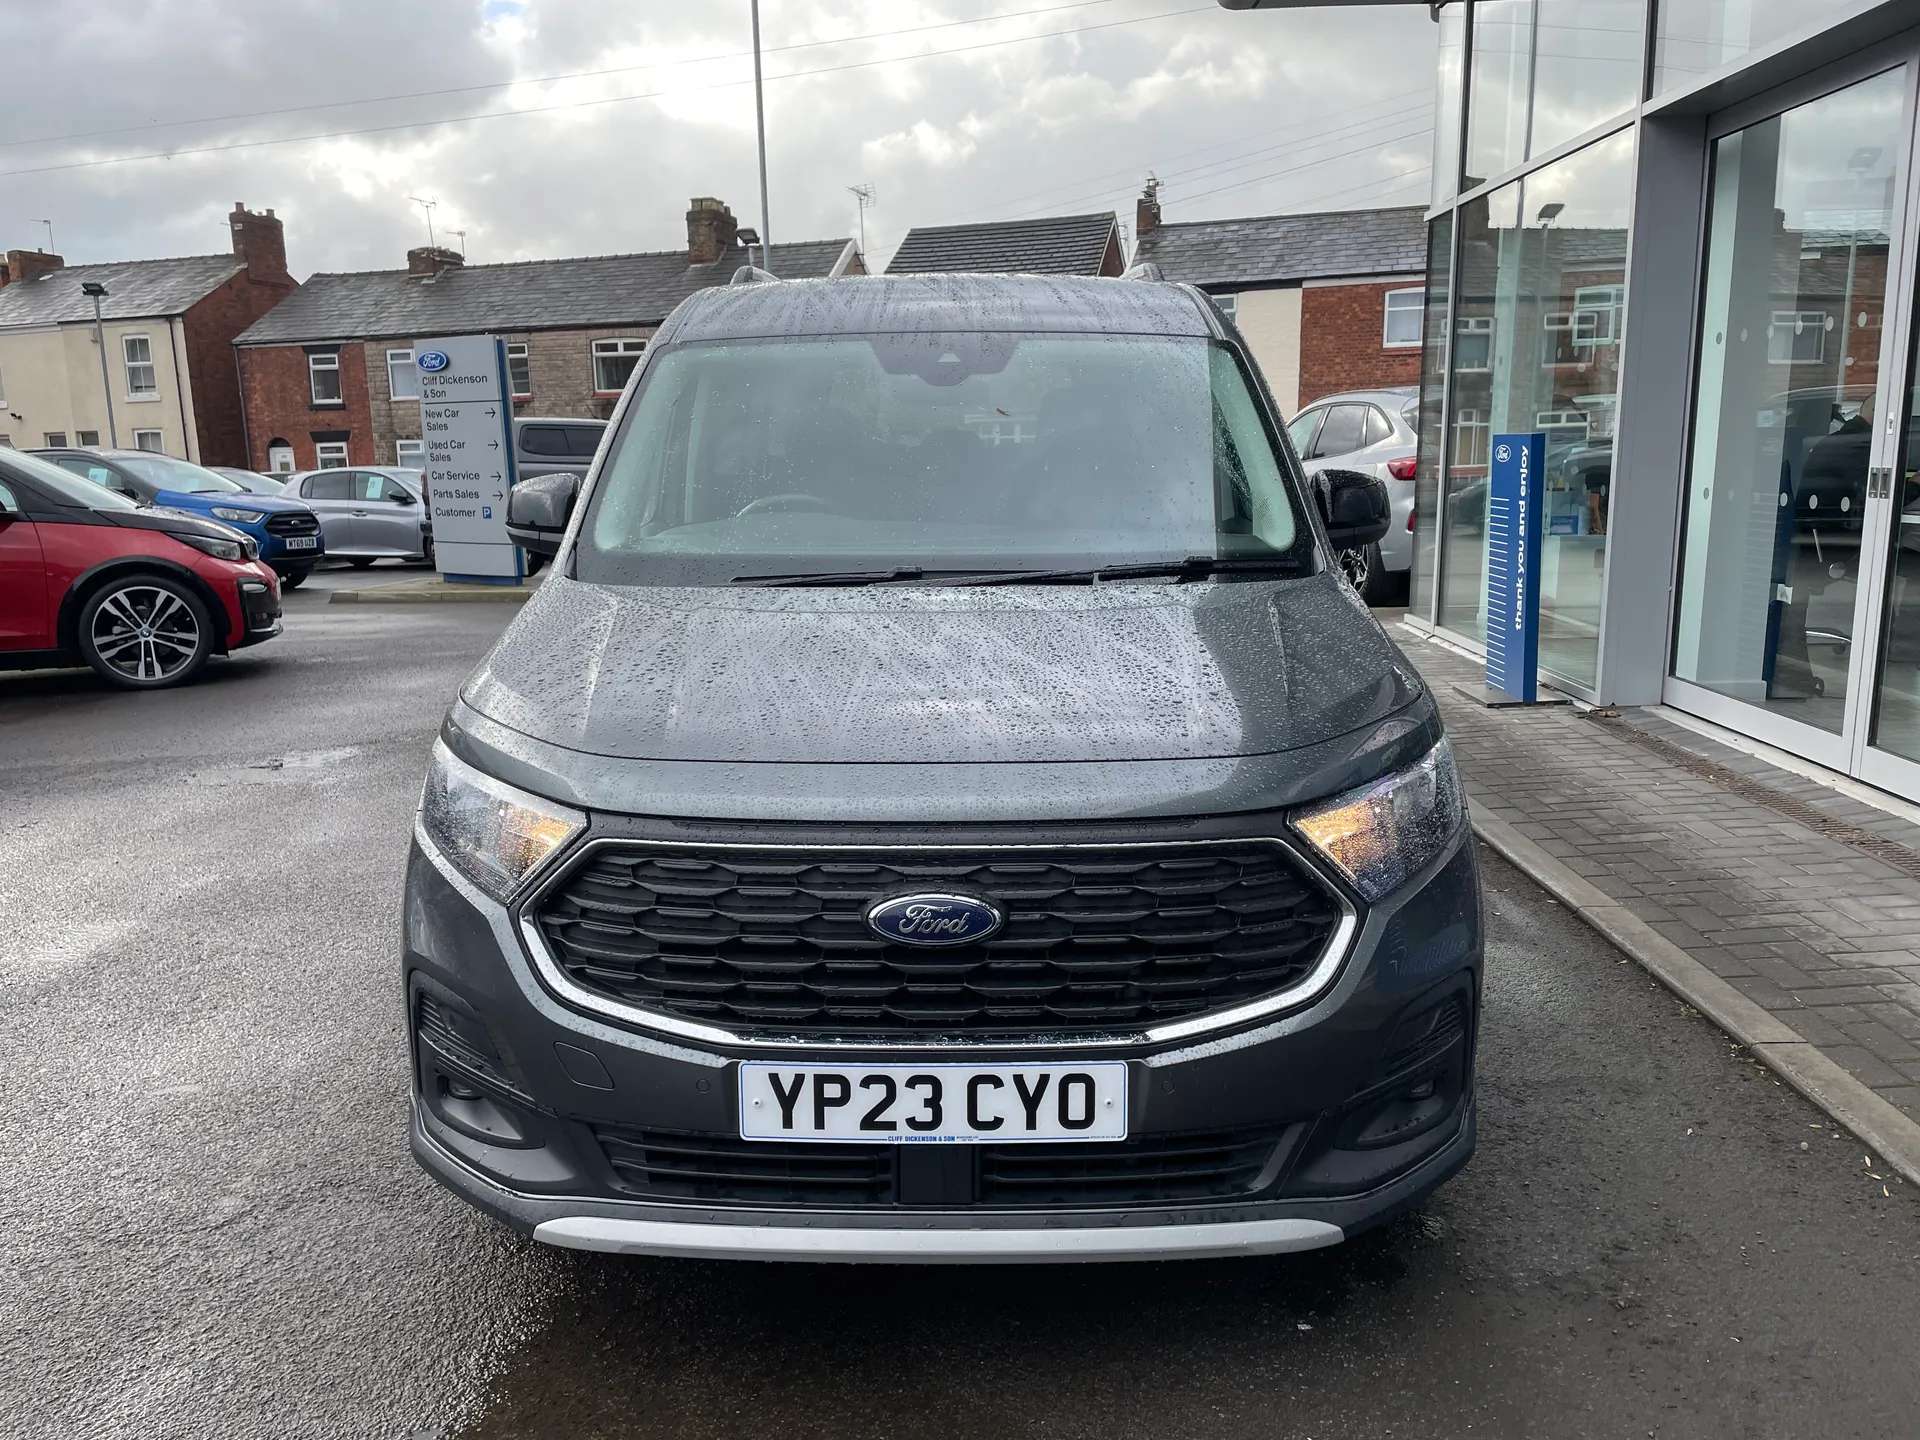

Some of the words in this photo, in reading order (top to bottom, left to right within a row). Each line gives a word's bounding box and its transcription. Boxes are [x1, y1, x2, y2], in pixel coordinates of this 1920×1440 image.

[423, 354, 440, 367] Ford
[422, 376, 438, 386] Cliff
[439, 375, 488, 385] Dickenson
[423, 389, 429, 399] &
[430, 389, 447, 398] Son
[425, 409, 443, 418] New
[444, 408, 459, 418] Car
[426, 422, 449, 431] Sales
[428, 440, 448, 450] Used
[449, 439, 466, 449] Car
[429, 453, 452, 462] Sales
[431, 470, 445, 480] Car
[446, 470, 480, 481] Service
[1519, 445, 1529, 497] enjoy
[433, 489, 453, 499] Parts
[455, 489, 480, 499] Sales
[435, 507, 476, 517] Customer
[483, 507, 491, 518] P
[1518, 500, 1526, 537] and
[1515, 577, 1523, 631] thank
[898, 904, 970, 934] Ford
[767, 1072, 943, 1132] YP23
[966, 1072, 1097, 1132] CYO
